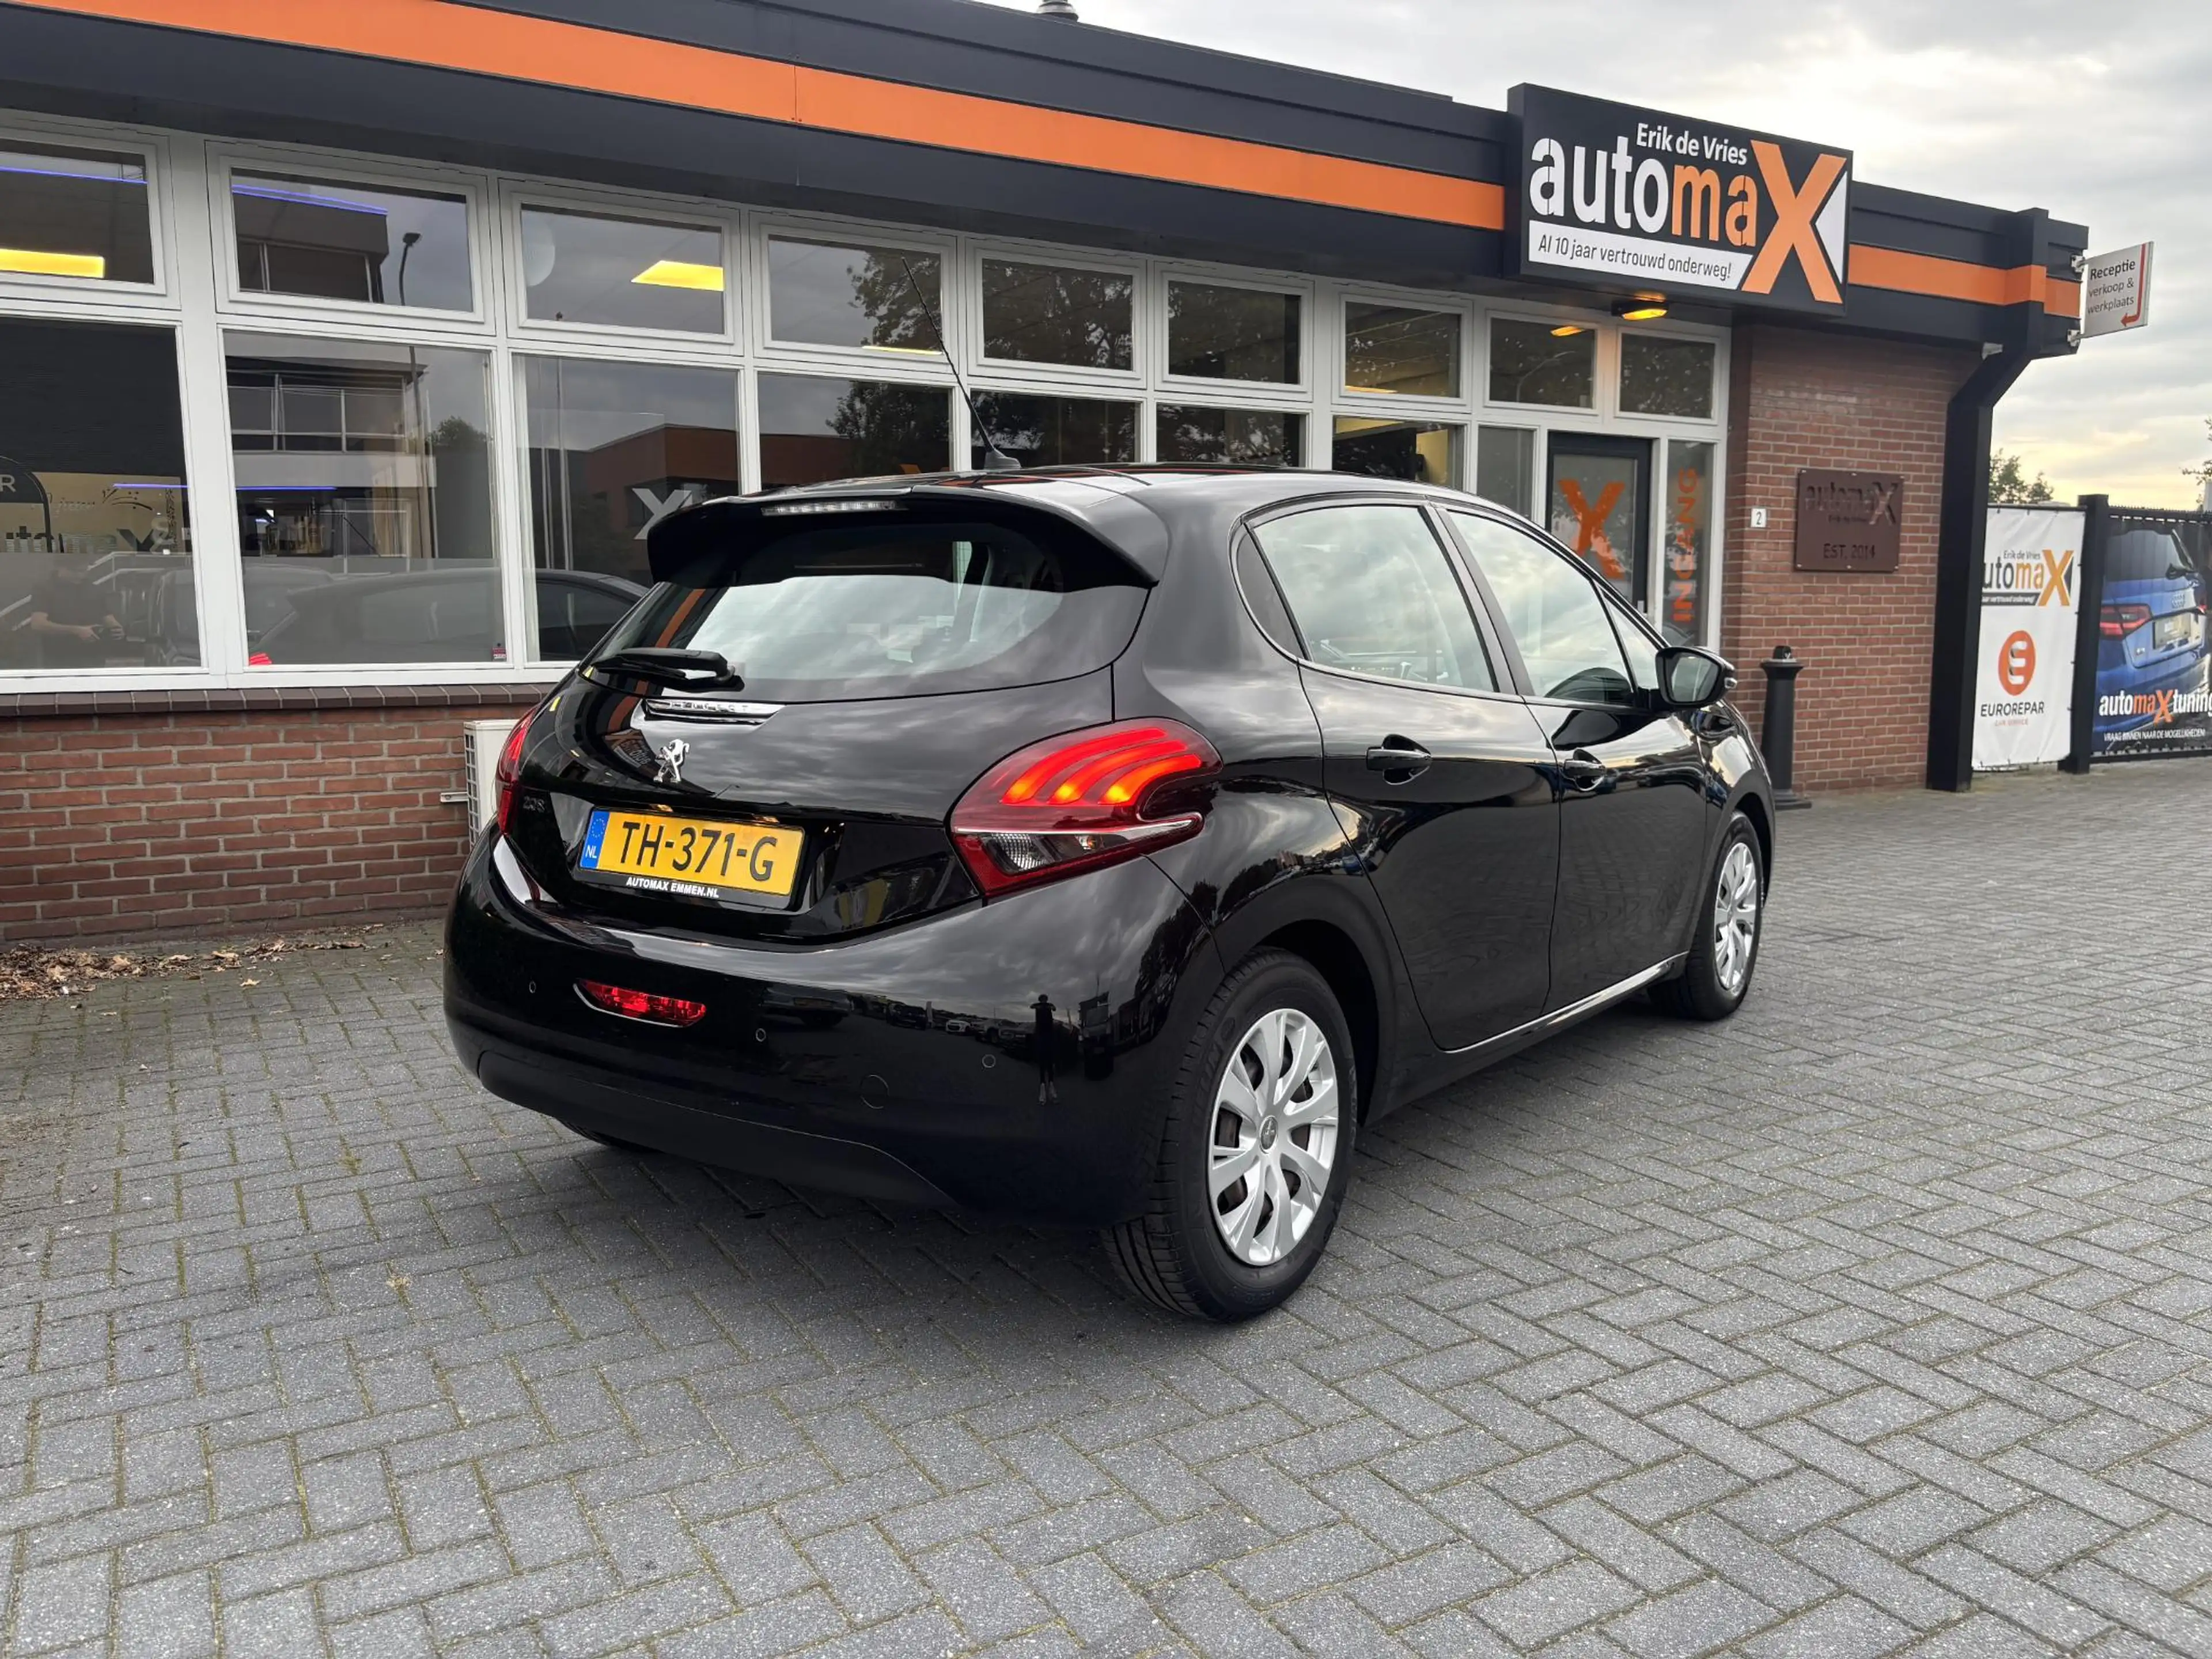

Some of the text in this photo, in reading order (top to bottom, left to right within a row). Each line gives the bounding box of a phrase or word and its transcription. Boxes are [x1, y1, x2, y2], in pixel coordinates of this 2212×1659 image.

[1637, 122, 1748, 166] Erik de Vries
[1529, 135, 1847, 305] automaX
[1555, 235, 1569, 256] 10
[1569, 238, 1597, 261] jaar
[1599, 244, 1665, 270] vertrouwd
[1668, 256, 1732, 281] onderweg!
[2090, 259, 2136, 280] Receptie
[2089, 277, 2134, 297] verkoop &
[2088, 296, 2135, 315] werkplaats
[1756, 511, 1762, 525] 2
[1559, 479, 1626, 579] X
[1673, 465, 1698, 622] INGANG
[1851, 544, 1875, 560] 2014
[2003, 550, 2040, 560] Erik de Vries
[1983, 550, 2074, 606] utomaX
[1980, 701, 2044, 717] EUROREPAR
[585, 846, 597, 859] NL
[620, 821, 778, 882] TH-371-G
[626, 877, 719, 899] AUTOMAX EMMEN.NL
